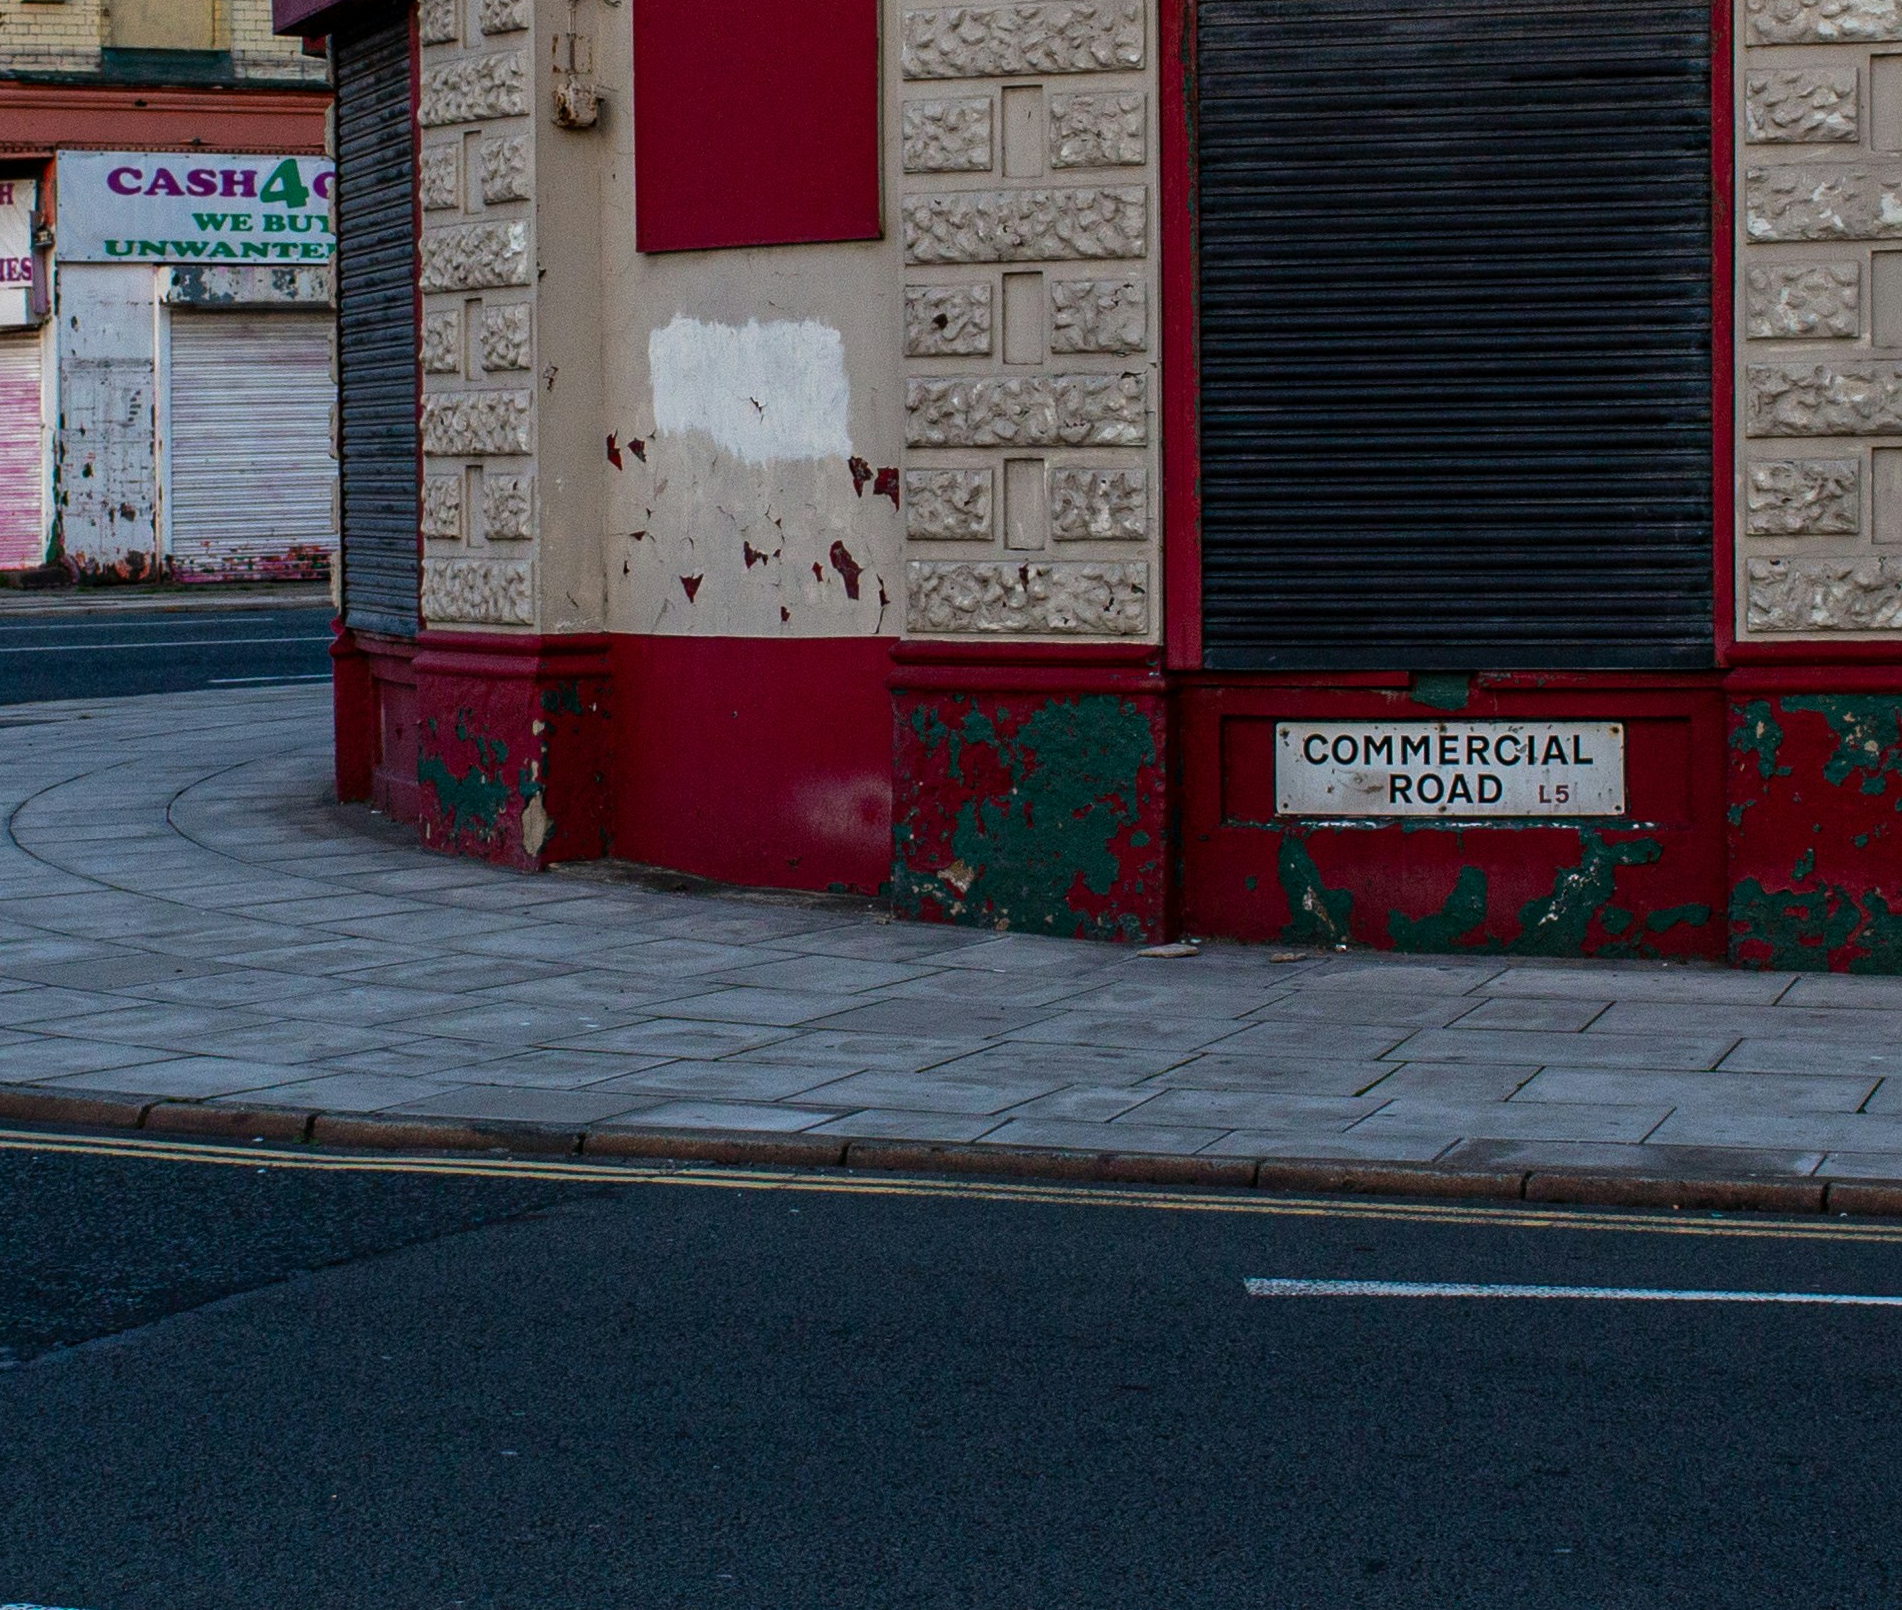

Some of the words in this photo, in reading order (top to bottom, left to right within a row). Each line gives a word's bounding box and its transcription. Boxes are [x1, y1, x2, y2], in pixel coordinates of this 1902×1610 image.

[192, 212, 253, 232] WE
[104, 239, 336, 260] UNWANTE
[1302, 733, 1594, 767] COMMERCIAL
[1389, 773, 1503, 804] ROAD
[1539, 784, 1570, 804] L5
